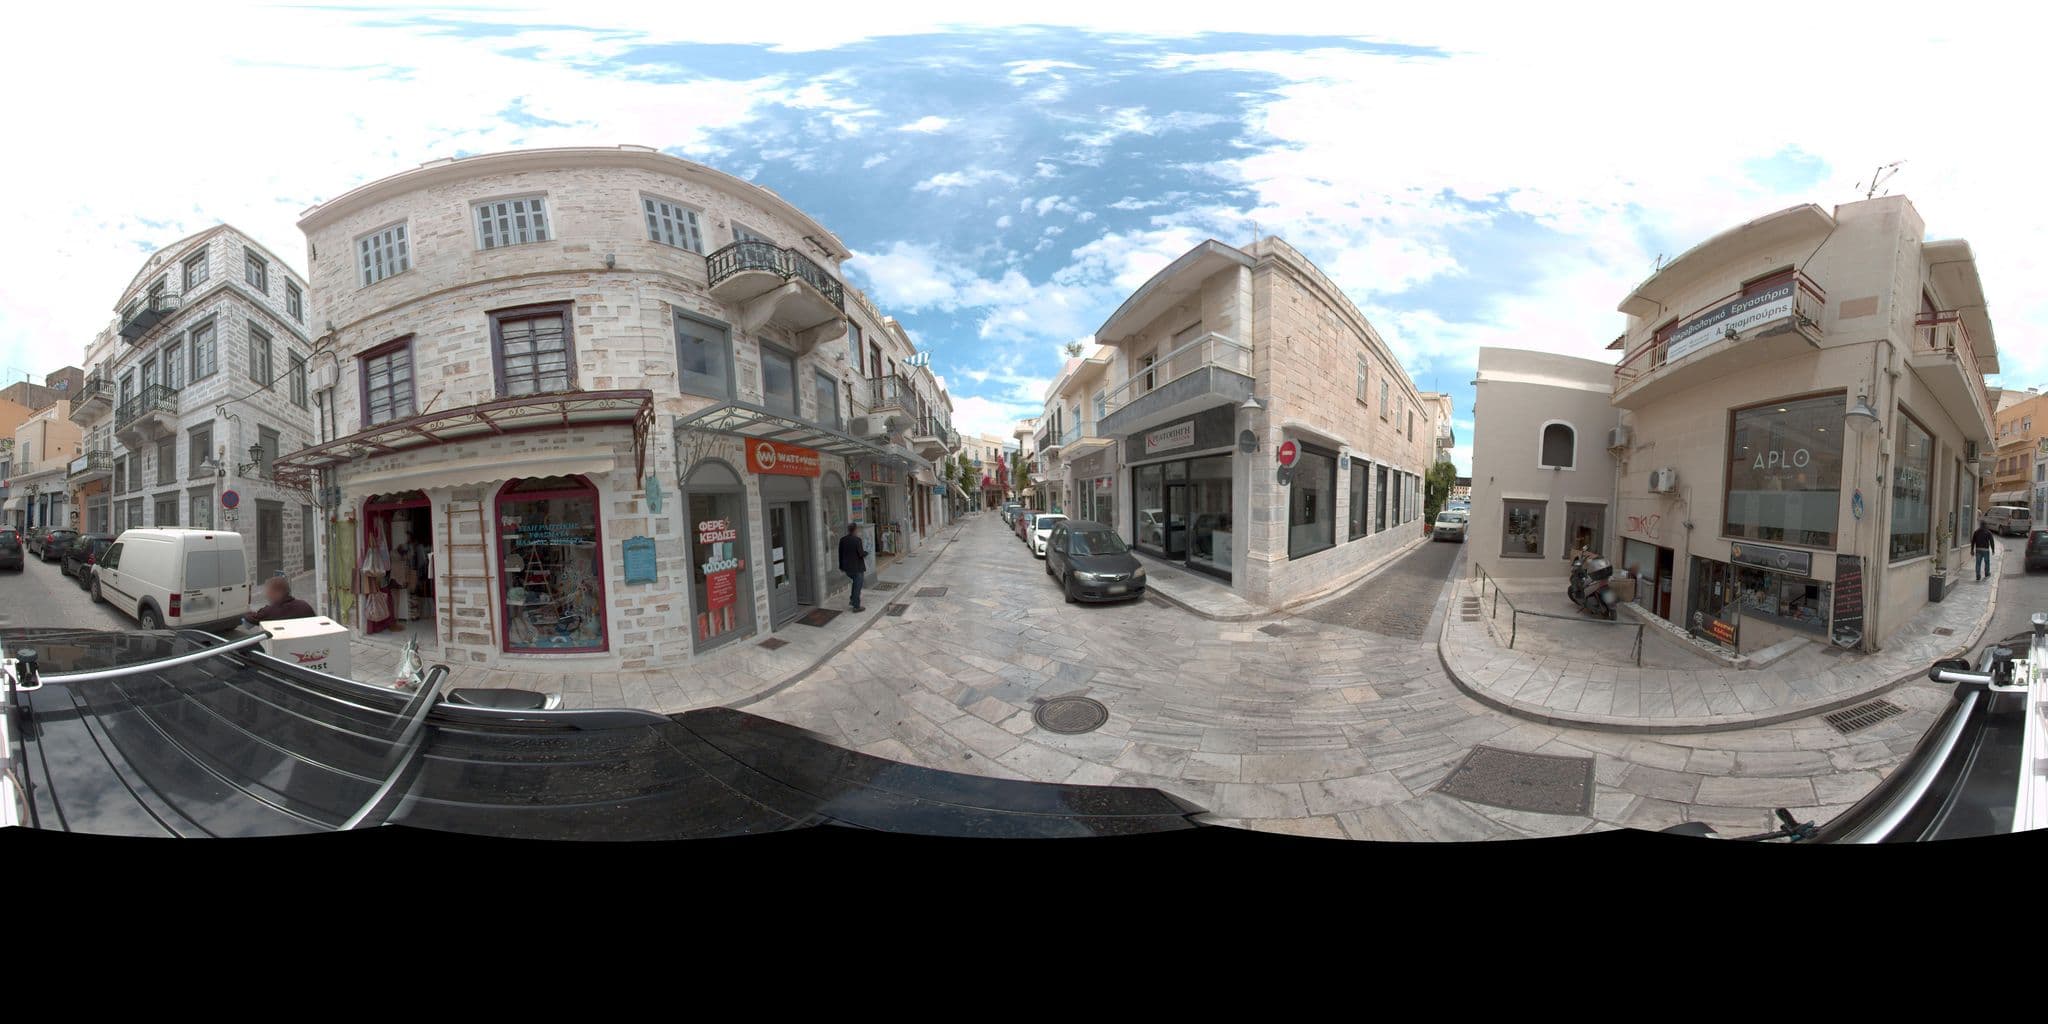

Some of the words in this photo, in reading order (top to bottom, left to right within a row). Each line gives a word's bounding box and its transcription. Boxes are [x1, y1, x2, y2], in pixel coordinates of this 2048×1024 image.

[1669, 310, 1727, 344] Μικροβιολογικό
[1731, 287, 1789, 314] Εργαστήριο
[1752, 448, 1810, 470] APLO
[699, 520, 725, 532] ΦΕΡΕ
[700, 530, 736, 544] ΚΕΡΔΙΣΕ
[702, 558, 738, 575] 10.000€
